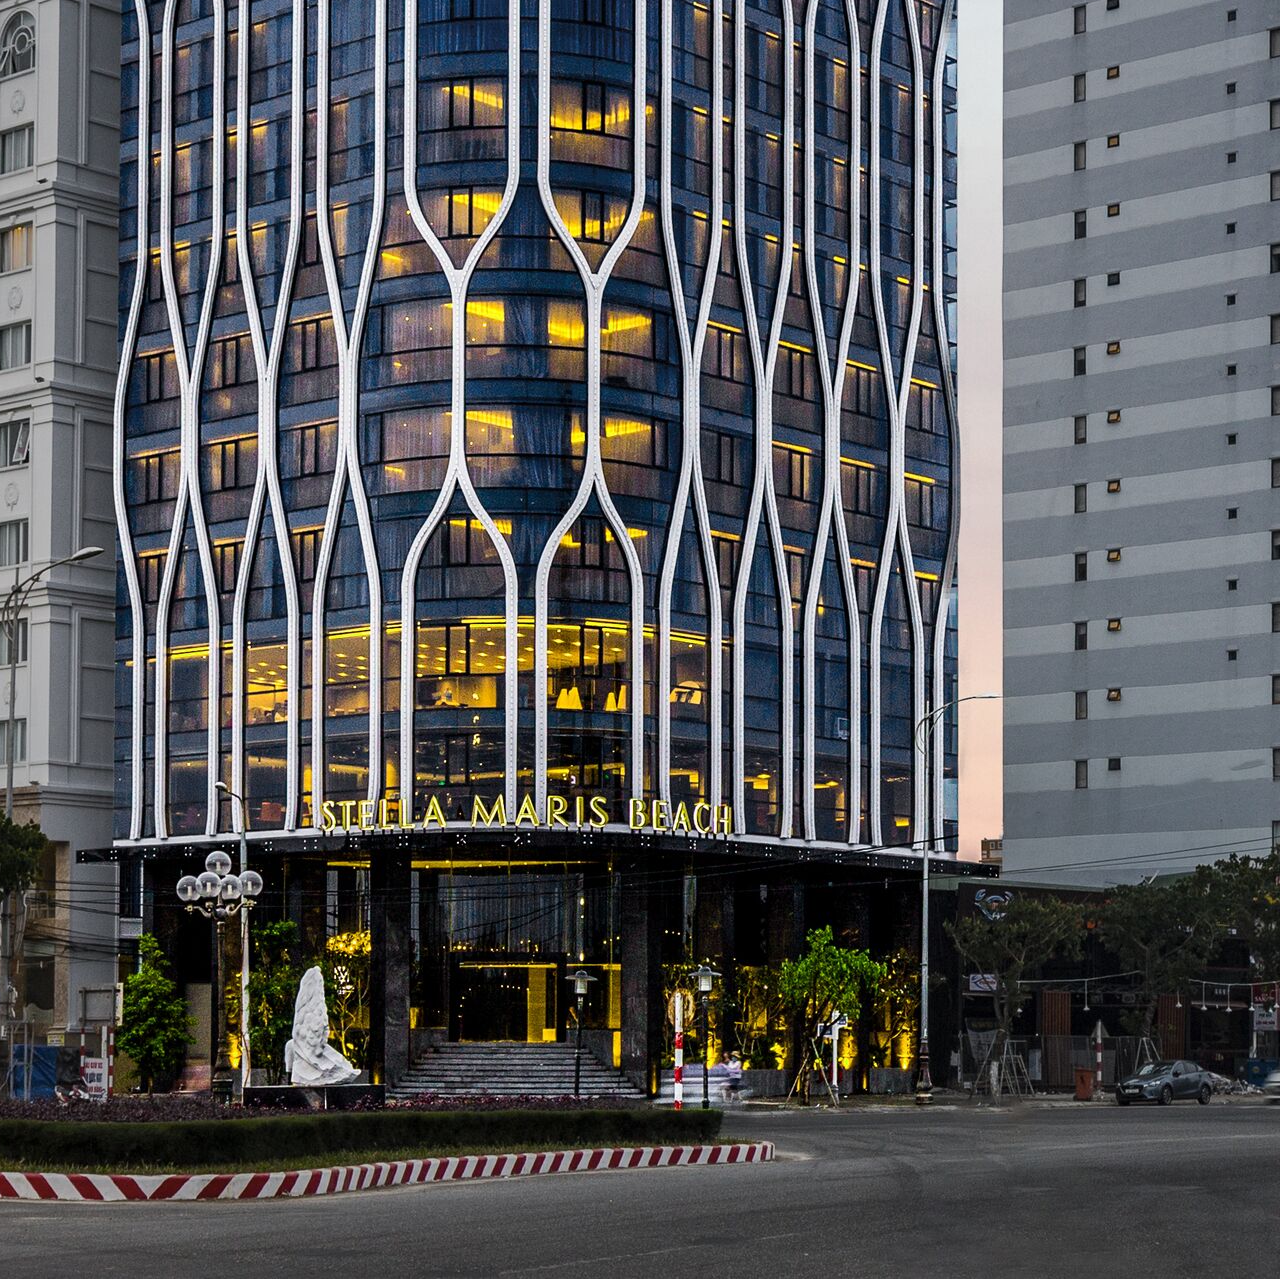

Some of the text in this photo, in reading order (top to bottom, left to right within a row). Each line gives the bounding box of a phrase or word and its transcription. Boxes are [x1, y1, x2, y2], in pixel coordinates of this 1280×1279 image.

[321, 793, 734, 836] STELLA MARIS BEACH
